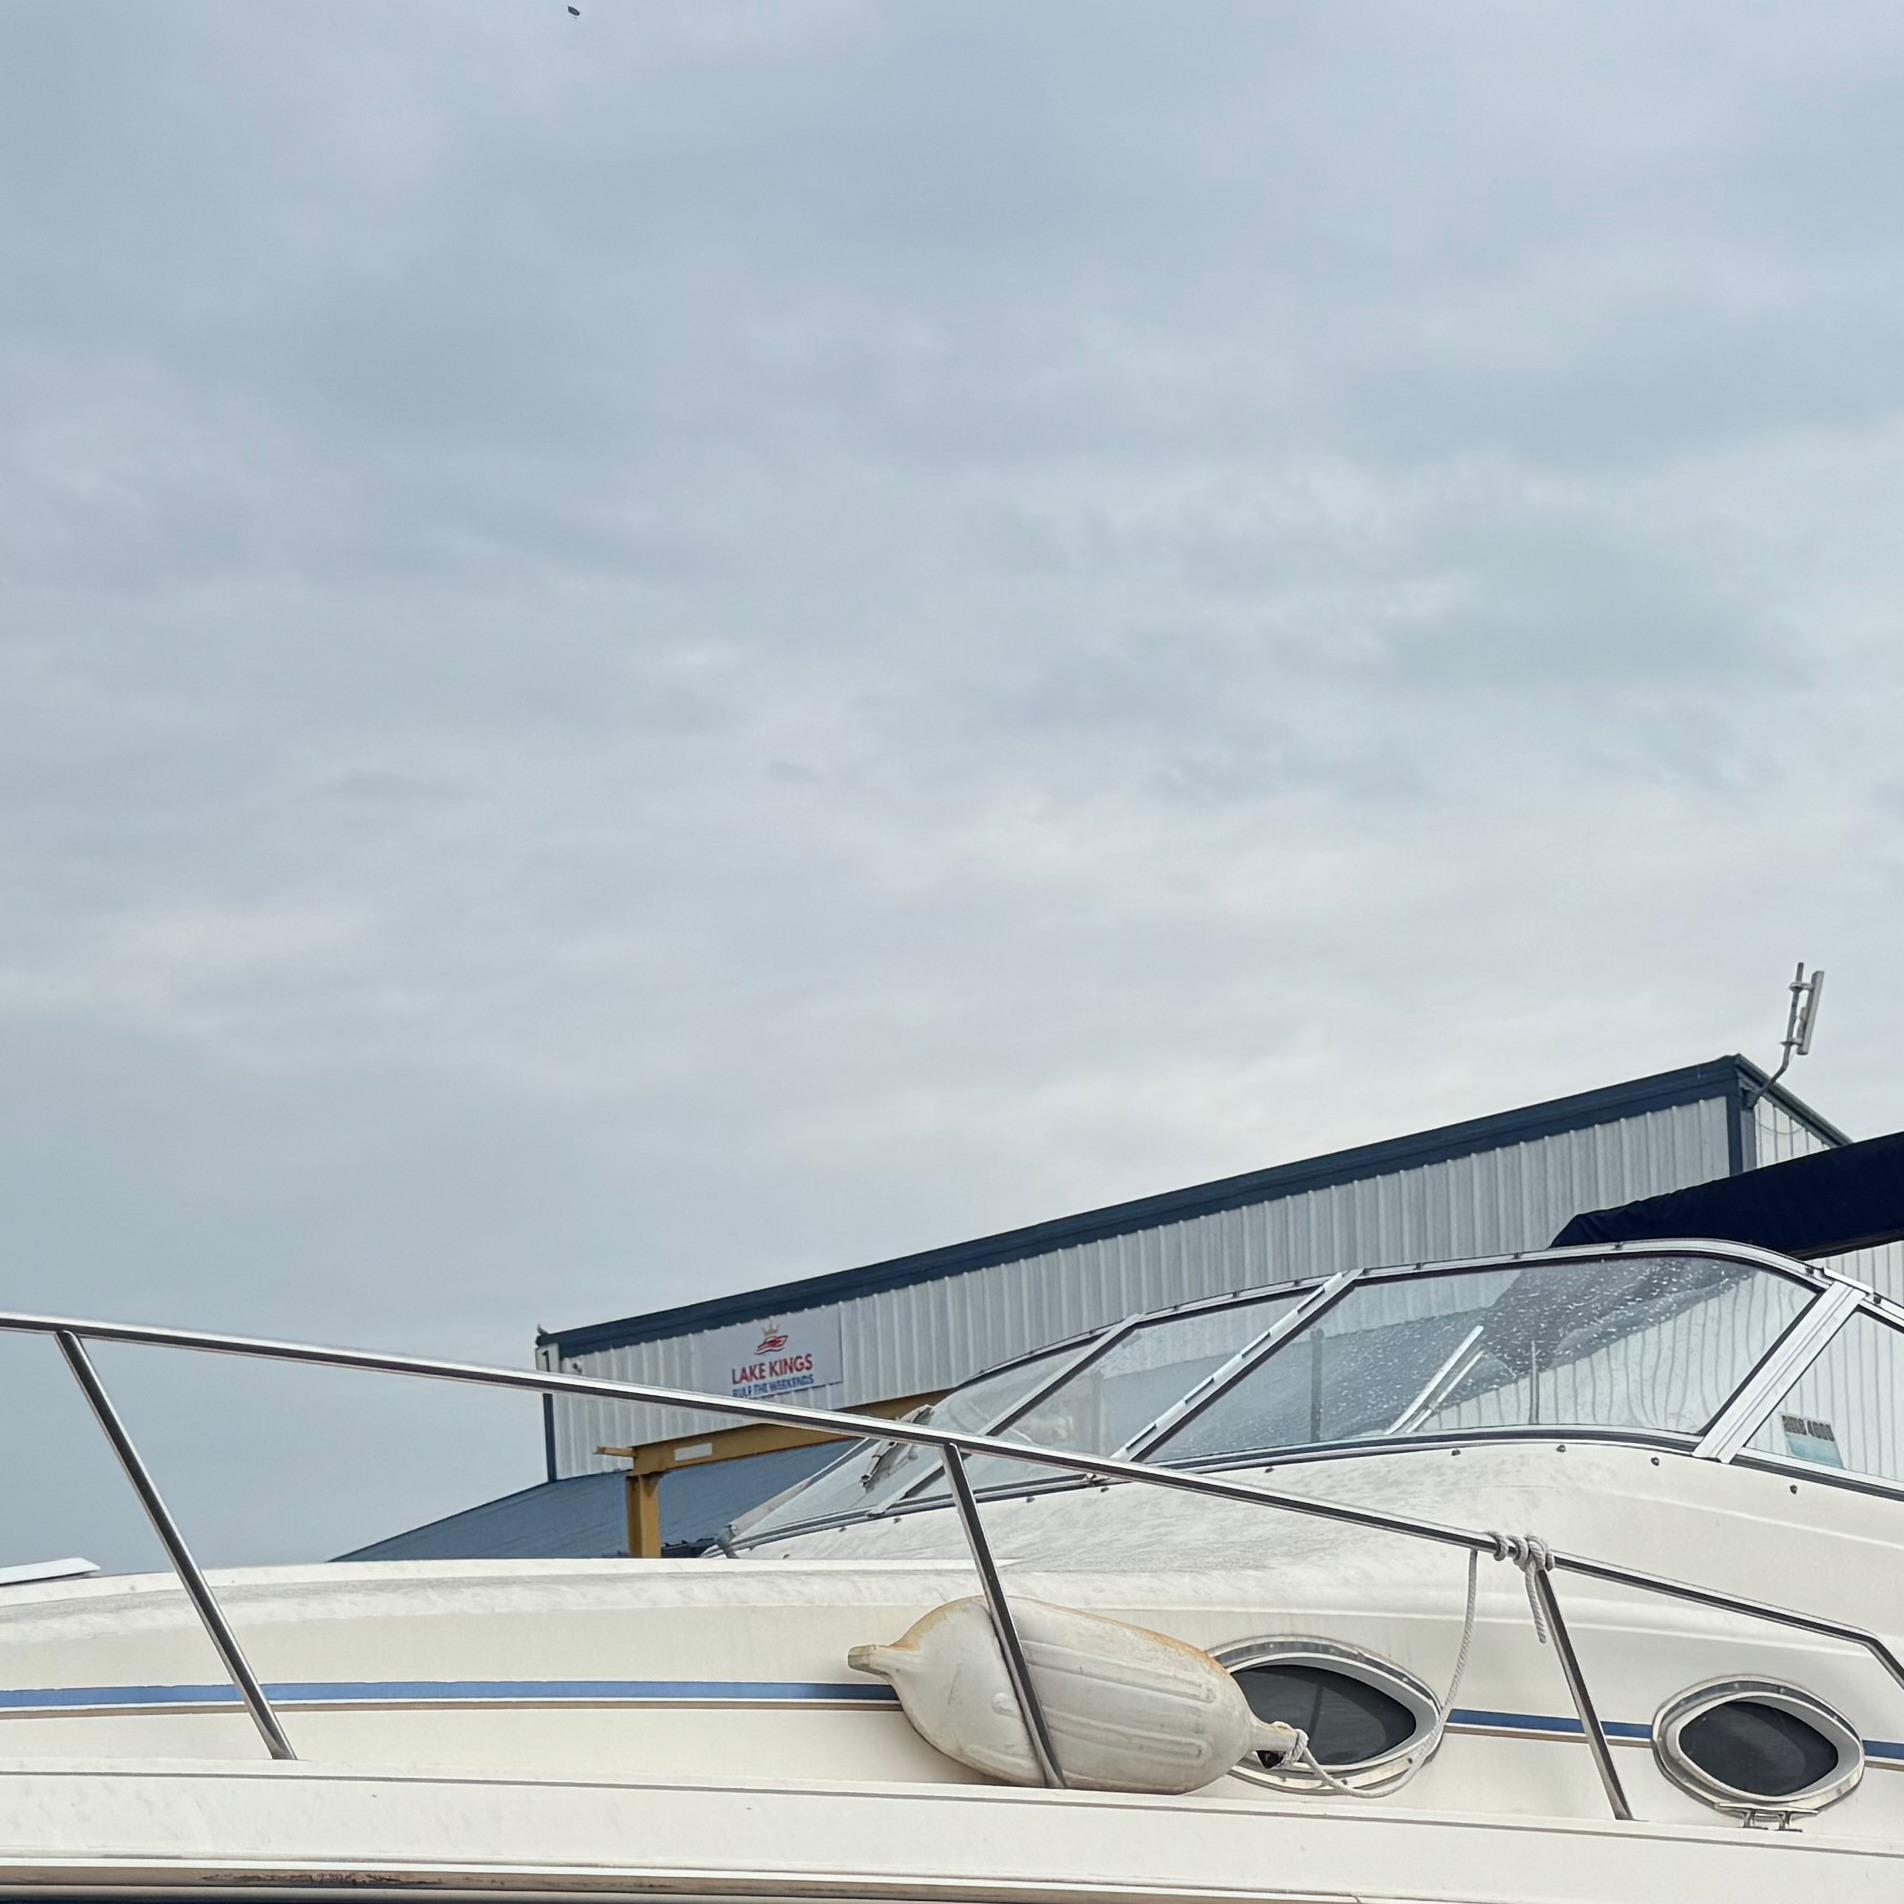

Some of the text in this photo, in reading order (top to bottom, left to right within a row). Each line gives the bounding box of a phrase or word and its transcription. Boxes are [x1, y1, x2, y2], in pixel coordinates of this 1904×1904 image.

[731, 1353, 813, 1385] LAKE KINGS
[769, 1374, 814, 1391] WEEKENDS
